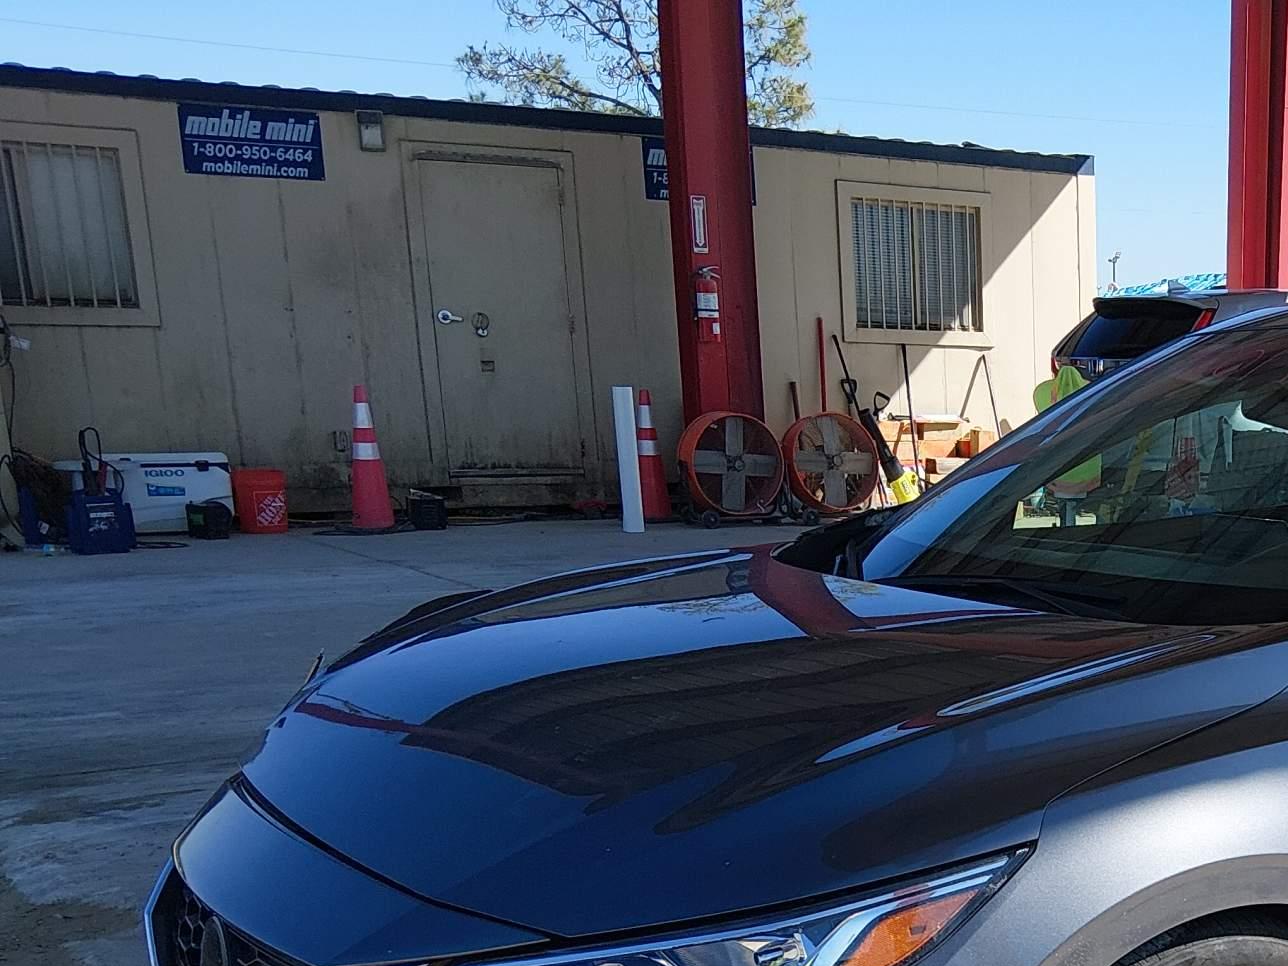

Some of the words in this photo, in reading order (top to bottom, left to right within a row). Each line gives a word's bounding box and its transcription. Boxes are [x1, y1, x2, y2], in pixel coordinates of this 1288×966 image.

[184, 109, 262, 139] mobile
[265, 118, 315, 142] mini
[192, 142, 313, 162] 1-800-950-6464
[202, 160, 308, 177] mobilemini.com
